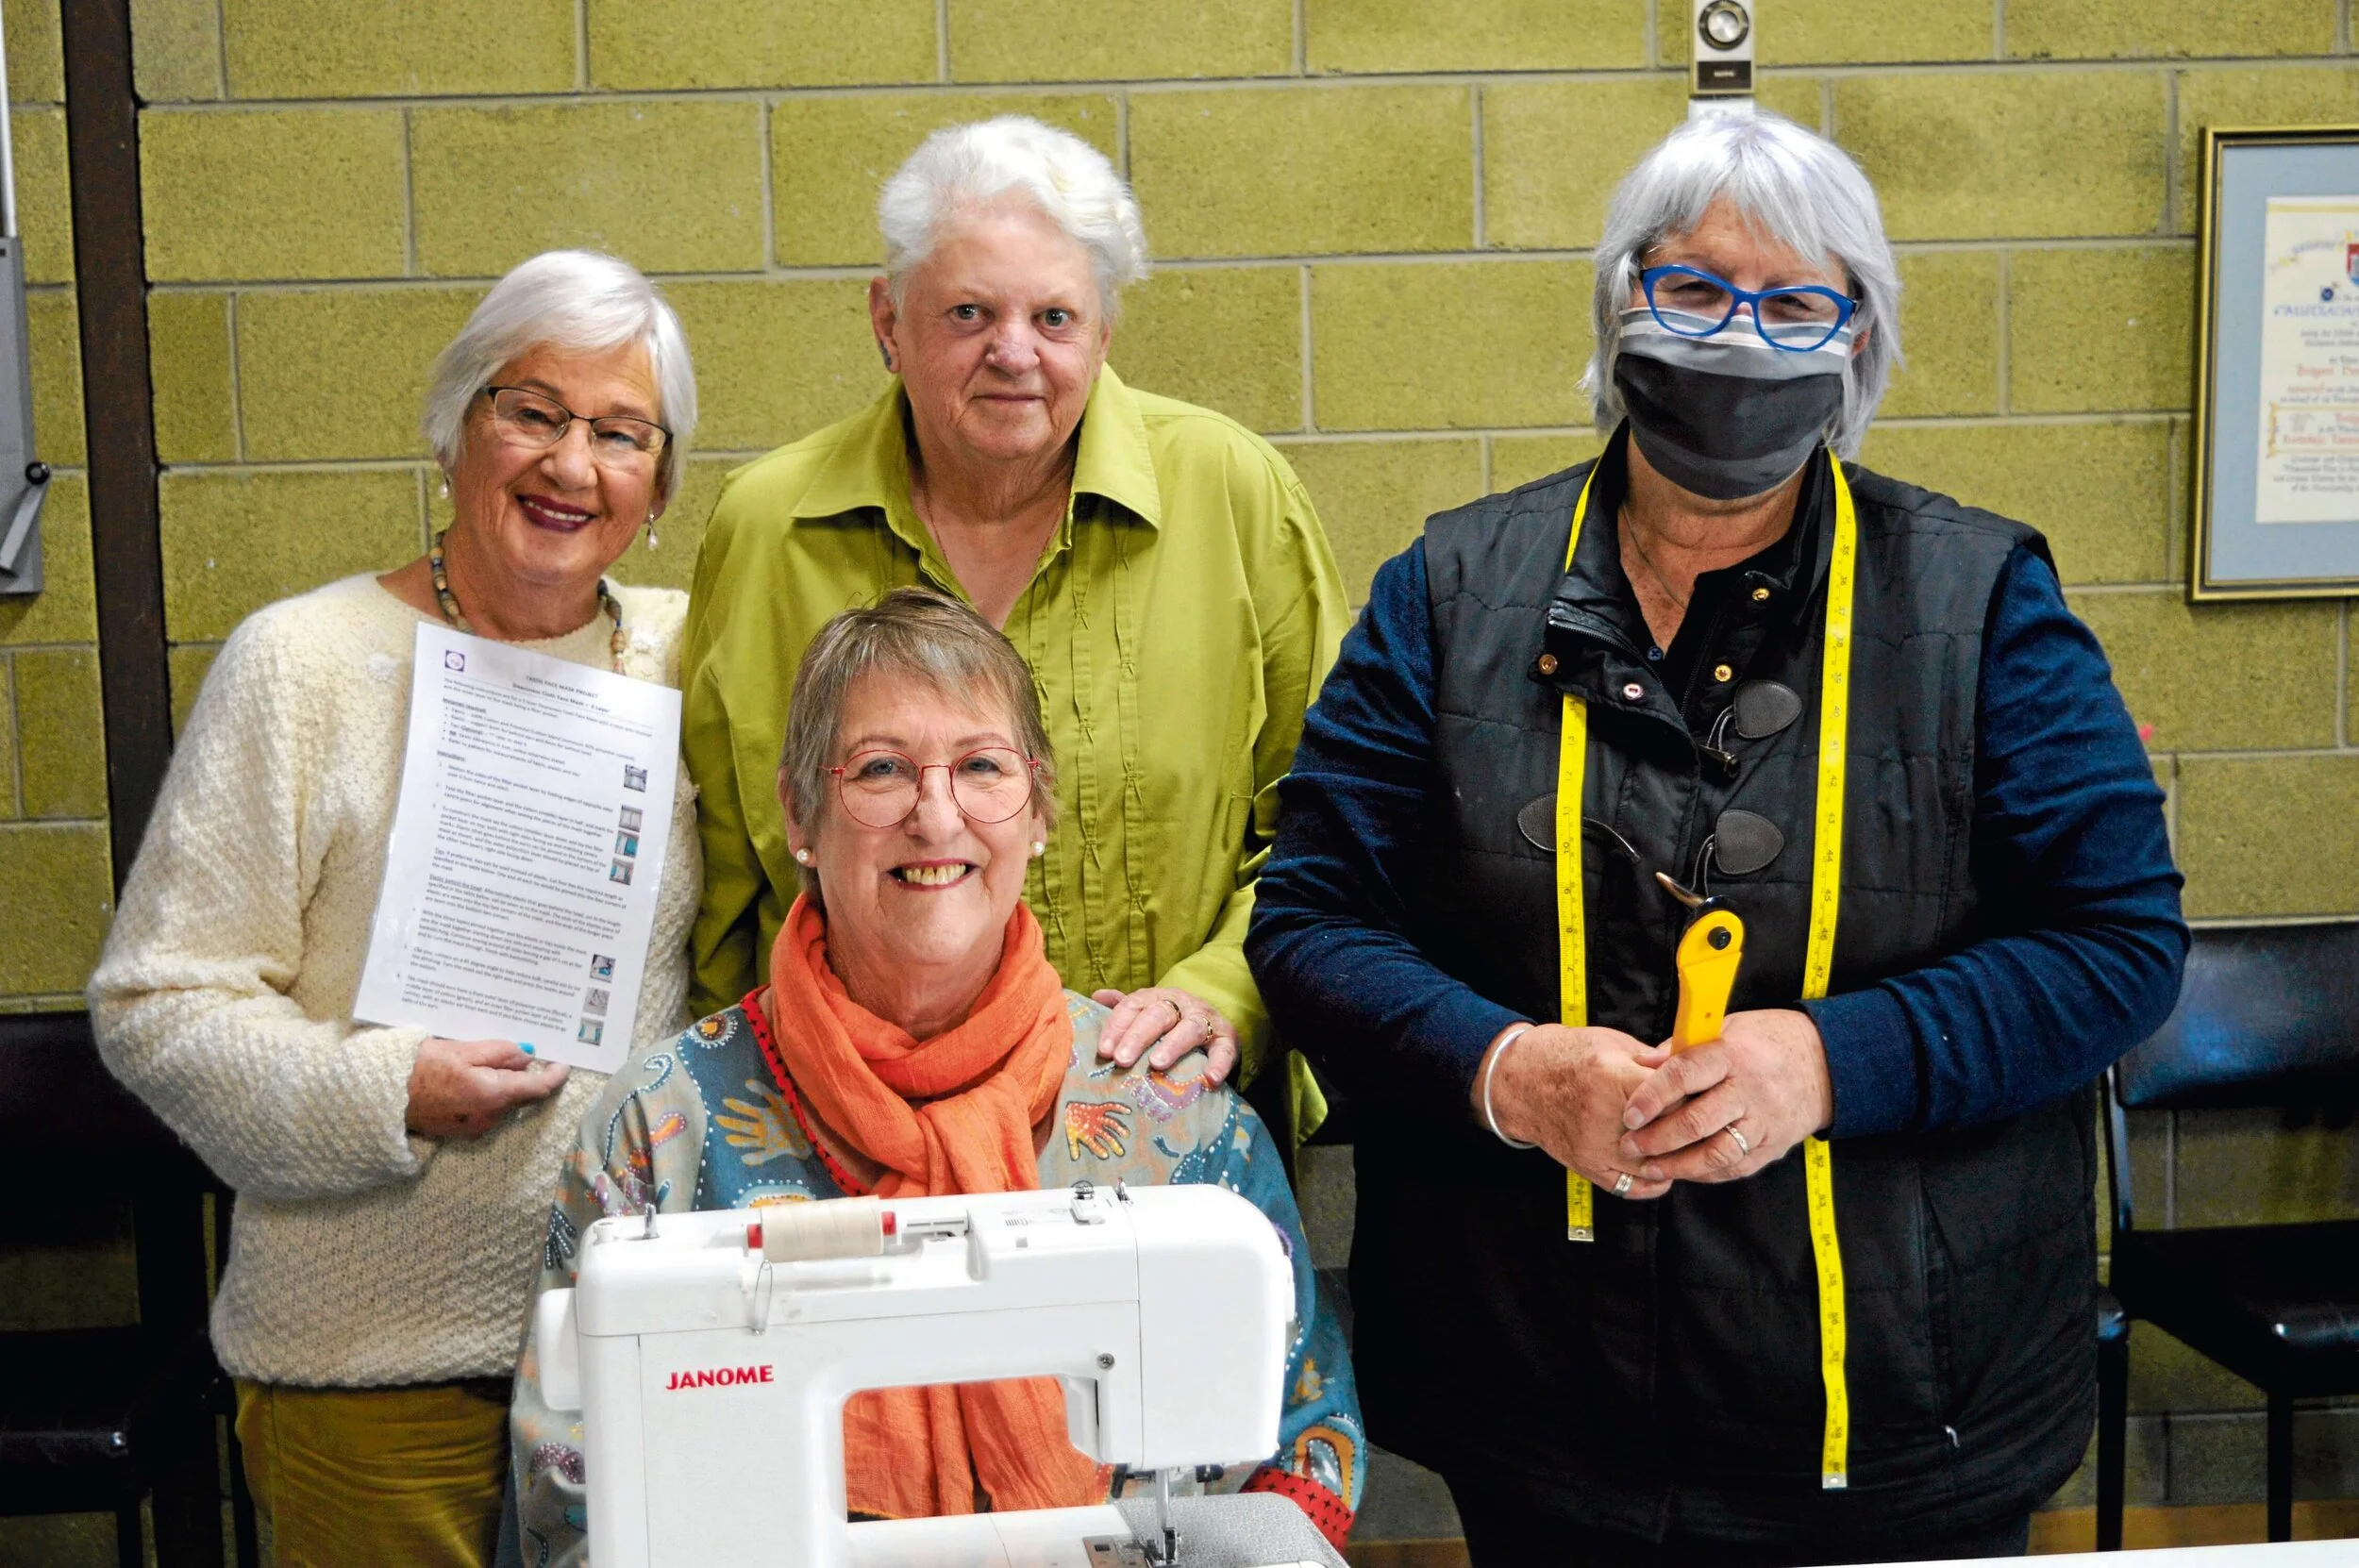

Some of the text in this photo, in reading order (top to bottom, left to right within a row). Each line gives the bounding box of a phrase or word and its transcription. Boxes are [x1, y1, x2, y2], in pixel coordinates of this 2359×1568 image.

[1833, 706, 1840, 717] 40
[1563, 842, 1570, 854] 10
[1824, 889, 1832, 902] 45
[1819, 927, 1828, 942] 46
[1815, 966, 1824, 979] 47
[665, 1364, 775, 1391] JANOME
